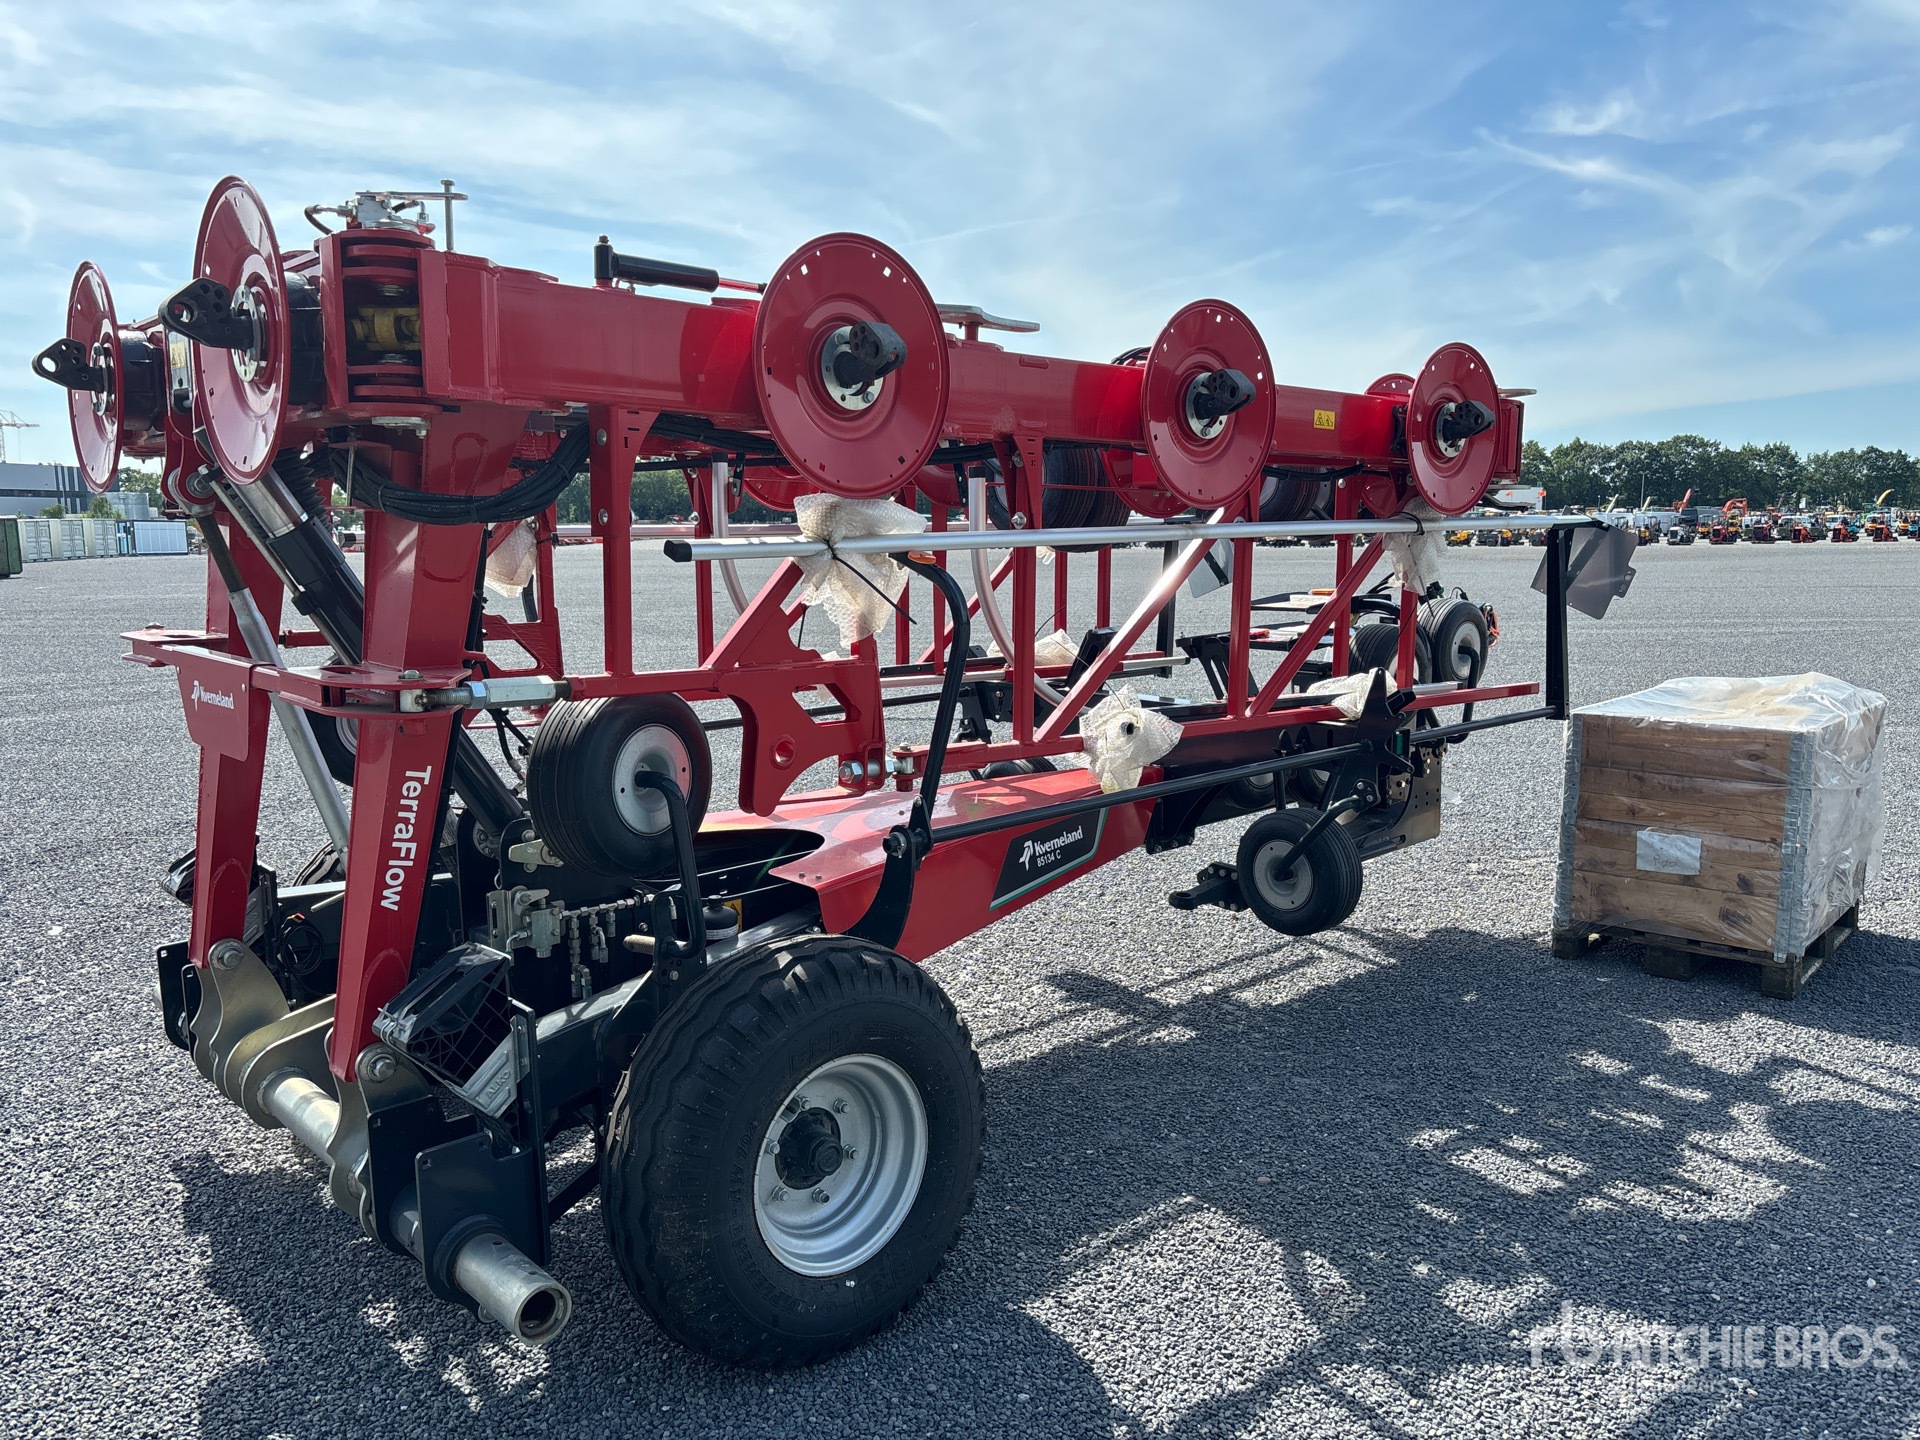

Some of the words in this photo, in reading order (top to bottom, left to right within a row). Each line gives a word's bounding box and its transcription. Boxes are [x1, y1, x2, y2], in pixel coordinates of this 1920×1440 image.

[200, 685, 235, 710] Kverneland
[380, 765, 432, 911] TerraFlow
[1034, 825, 1084, 857] Kverneland
[1037, 853, 1055, 867] 85134
[1055, 849, 1062, 860] C
[735, 1120, 758, 1159] 702
